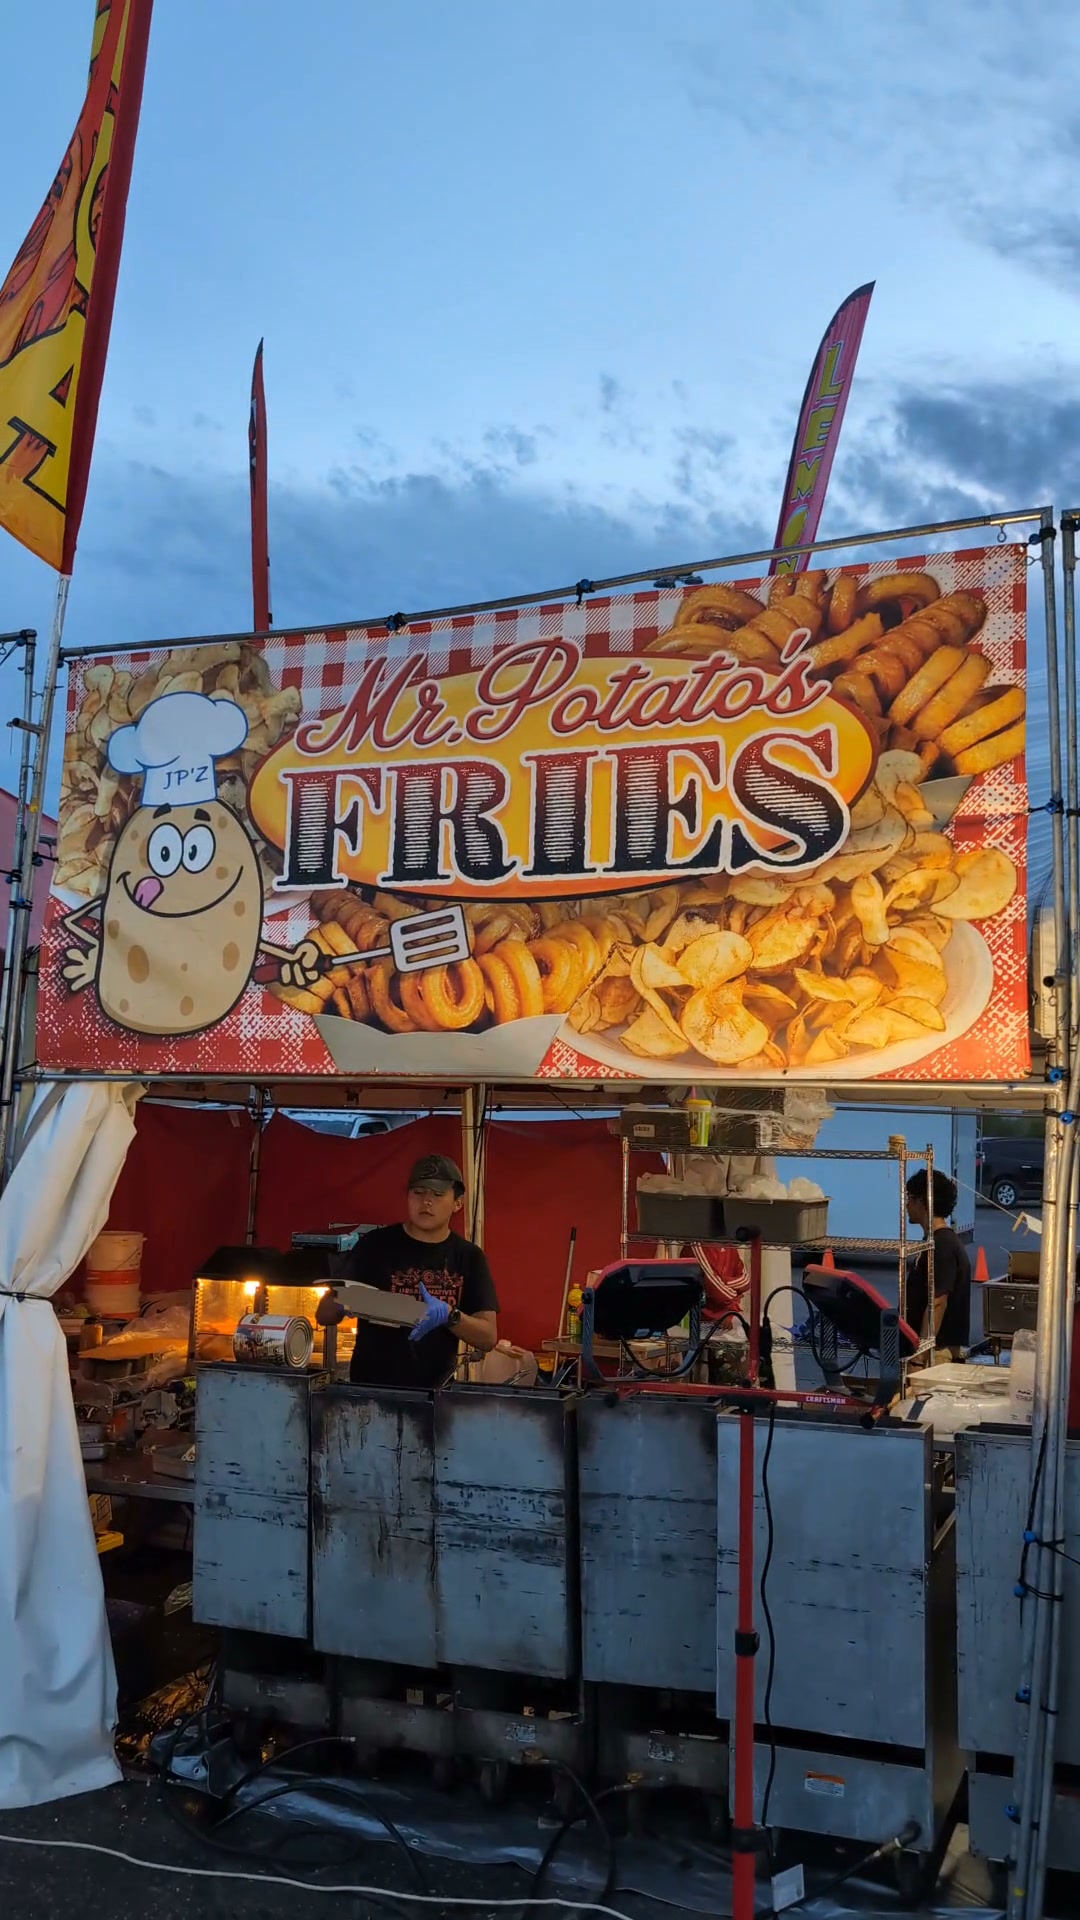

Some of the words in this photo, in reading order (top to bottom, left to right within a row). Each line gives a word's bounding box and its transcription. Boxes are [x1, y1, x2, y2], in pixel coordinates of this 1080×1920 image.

[298, 655, 461, 754] Mr.
[466, 631, 830, 739] Potato's
[163, 765, 209, 790] JP'Z
[274, 728, 848, 889] FRIES
[805, 1395, 846, 1404] CRAFTSMAN
